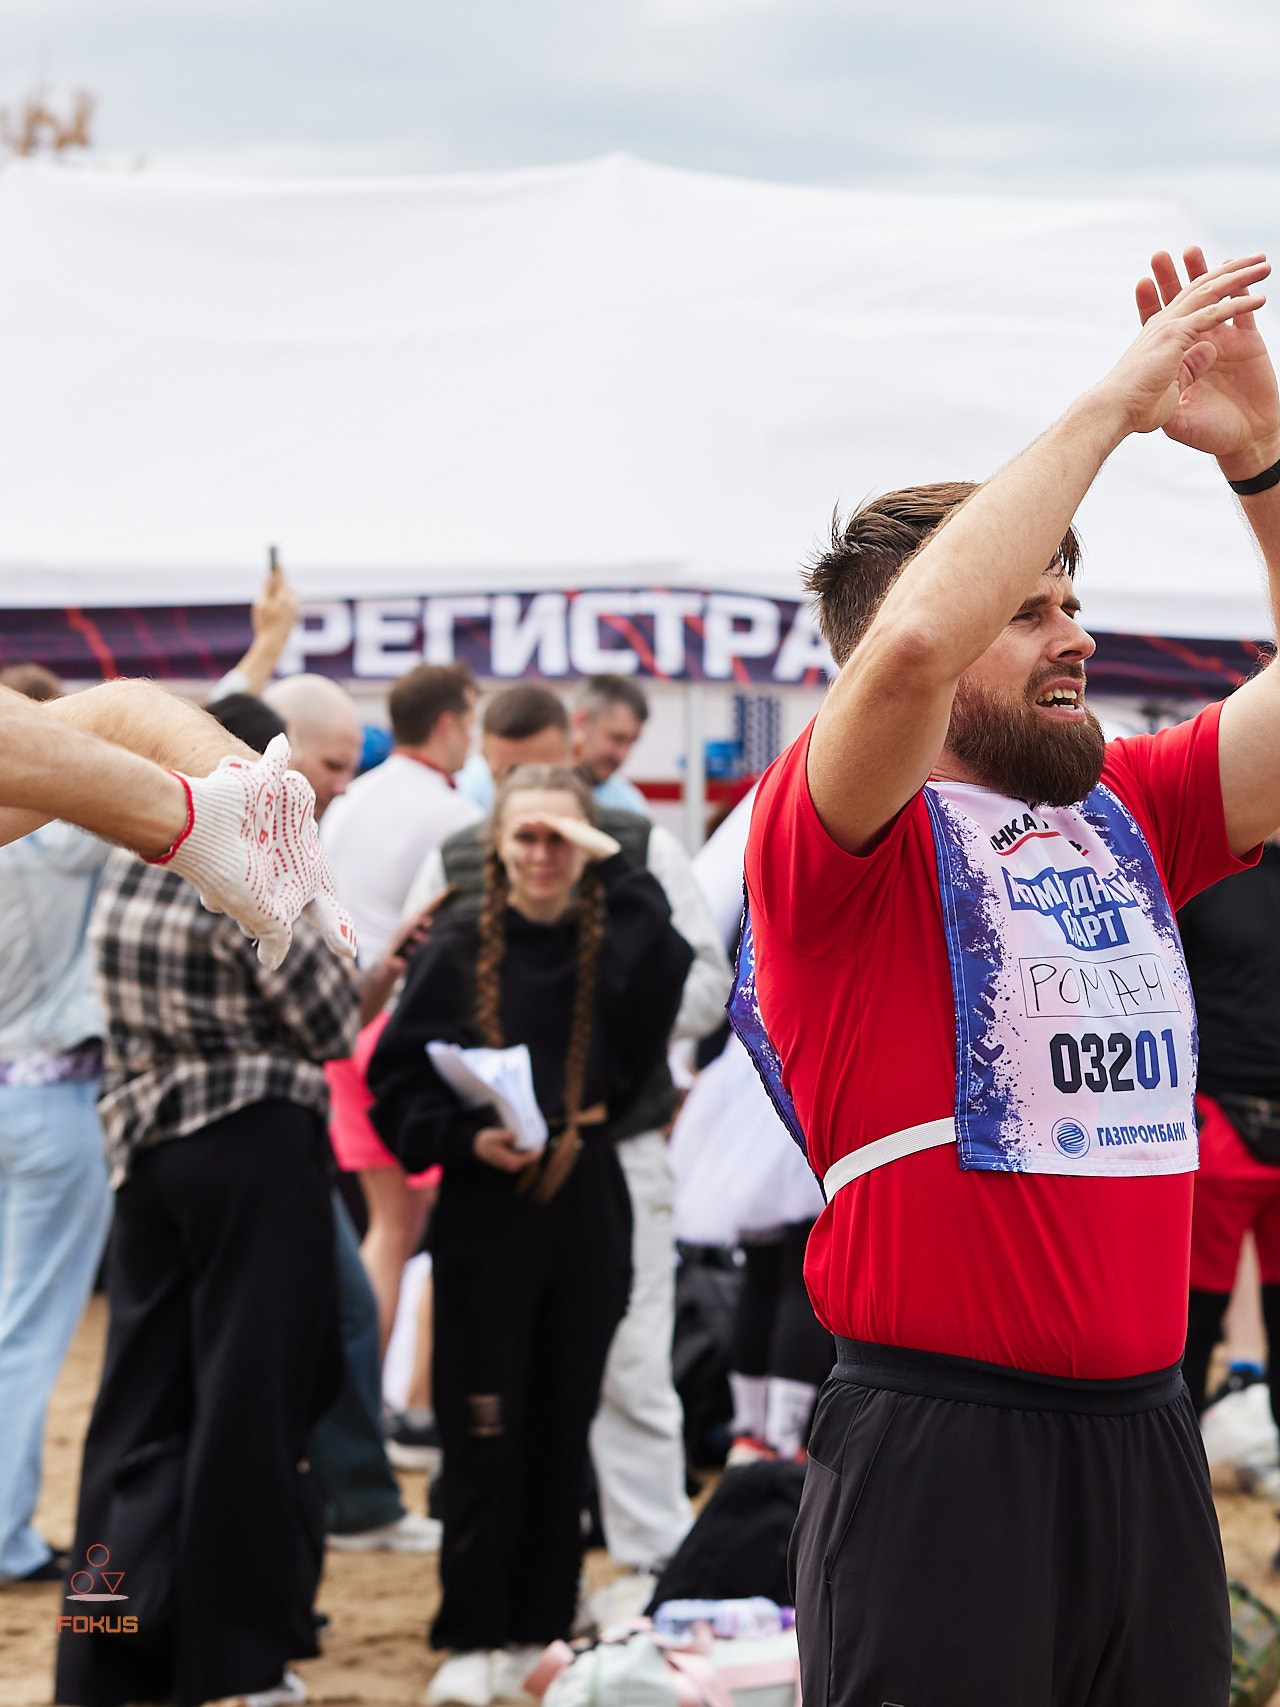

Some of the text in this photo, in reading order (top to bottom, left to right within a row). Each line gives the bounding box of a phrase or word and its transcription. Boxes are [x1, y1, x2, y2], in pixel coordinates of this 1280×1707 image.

[280, 590, 840, 682] РЕГИСТРА
[989, 812, 1038, 851] НКА
[1028, 963, 1168, 1015] РОМАН
[1049, 1028, 1179, 1094] 03201
[1096, 1121, 1189, 1147] ГАЗПРОМБАНК
